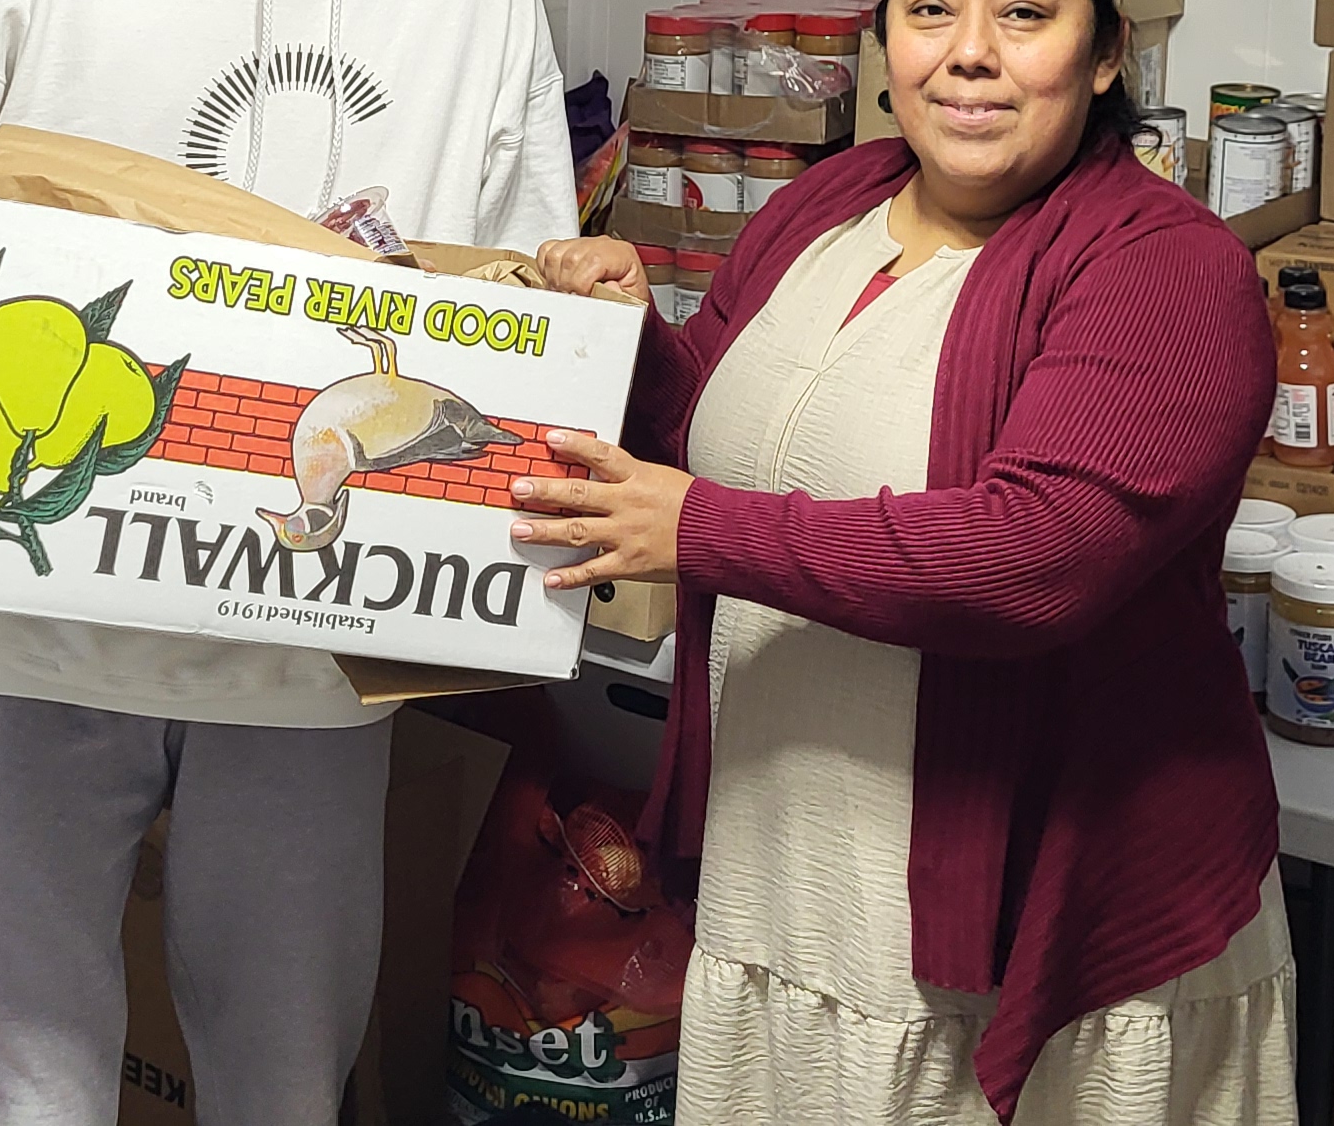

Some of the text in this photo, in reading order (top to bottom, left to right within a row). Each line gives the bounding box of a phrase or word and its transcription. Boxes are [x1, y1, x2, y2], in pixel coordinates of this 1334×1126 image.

[167, 255, 550, 357] HOOD RIVER PEARS
[129, 487, 188, 512] brand
[84, 505, 531, 627] DUCKWALL
[451, 997, 608, 1069] nset
[126, 1051, 186, 1110] KEE
[624, 1076, 676, 1103] PRODUCT
[513, 1093, 610, 1122] OONS
[634, 1106, 672, 1124] U.S.A.
[644, 1094, 661, 1109] OF
